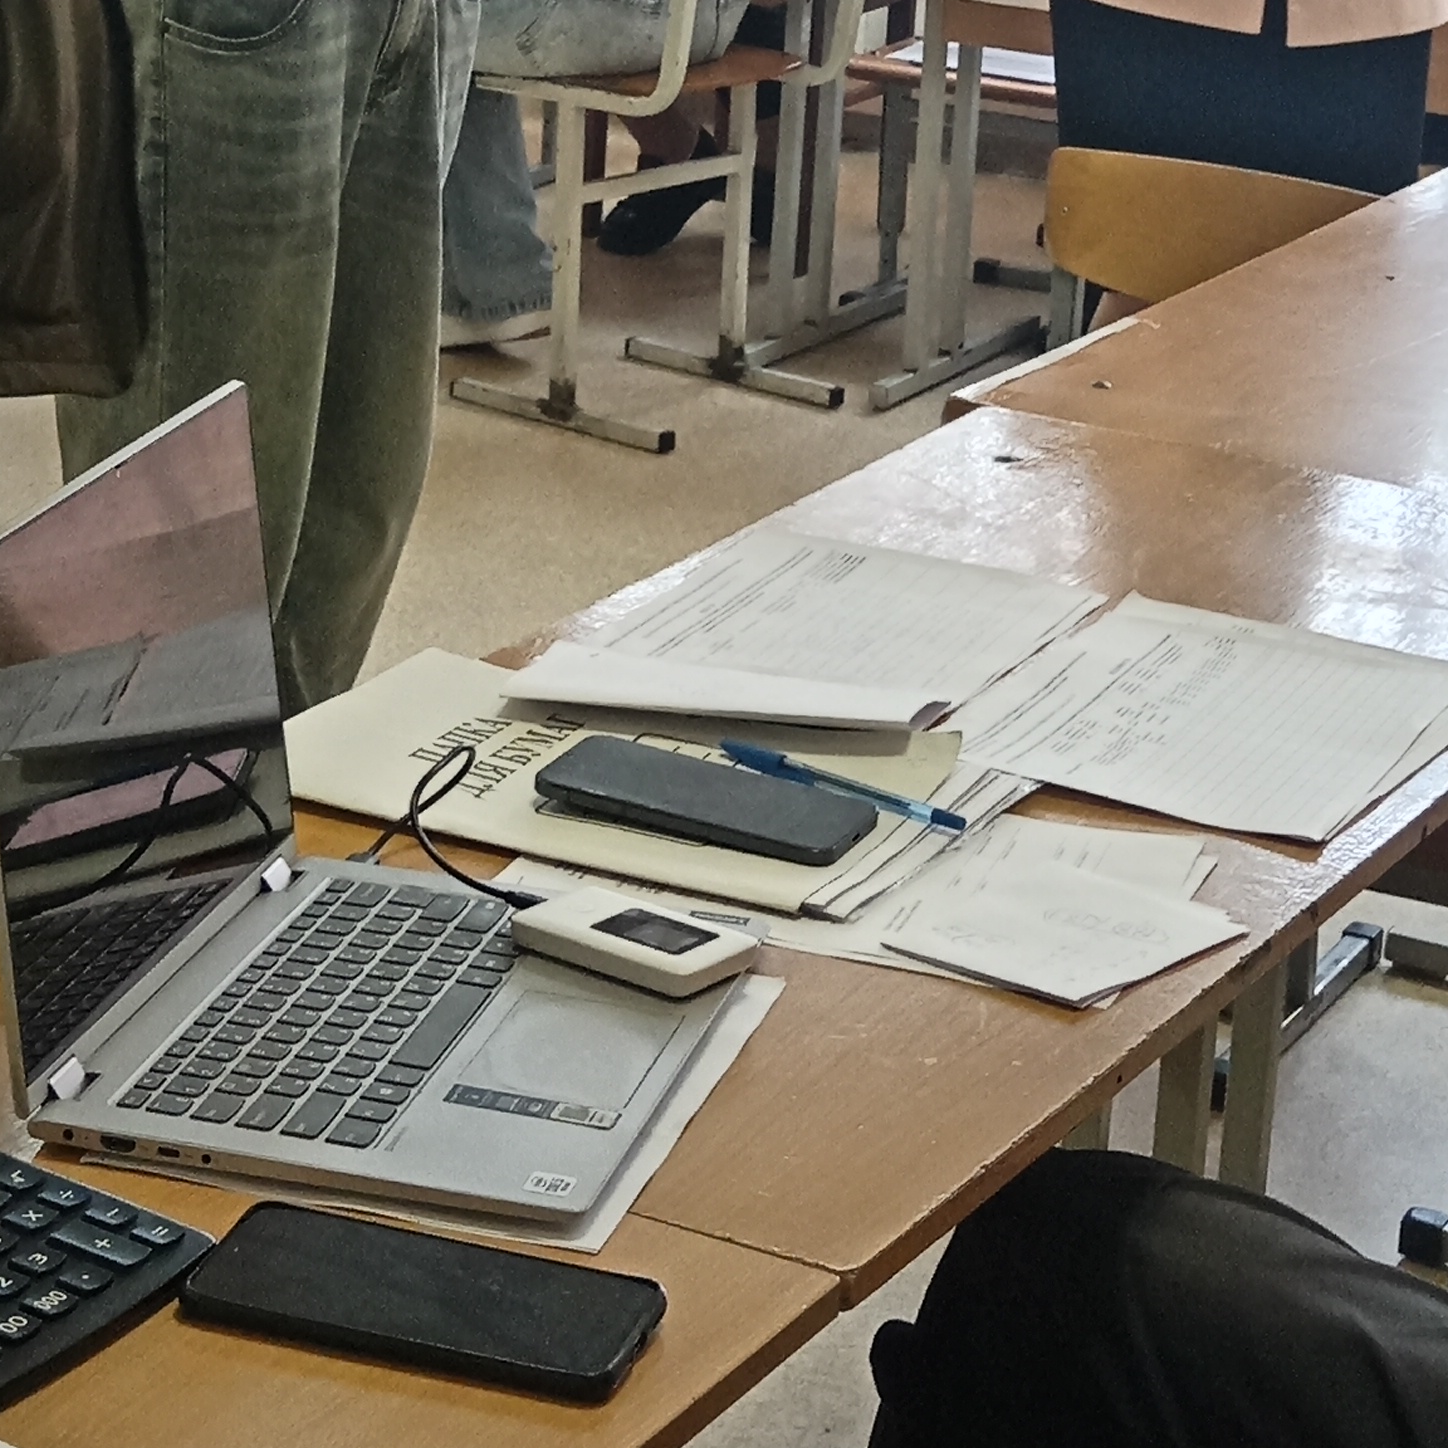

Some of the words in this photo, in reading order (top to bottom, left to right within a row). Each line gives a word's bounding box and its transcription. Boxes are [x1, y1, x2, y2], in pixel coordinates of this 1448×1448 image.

[408, 716, 513, 764] ПАПКА
[457, 760, 517, 800] ДЛЯ
[487, 711, 586, 766] БУМАГ
[28, 1252, 48, 1266] 3
[33, 1290, 67, 1311] 000
